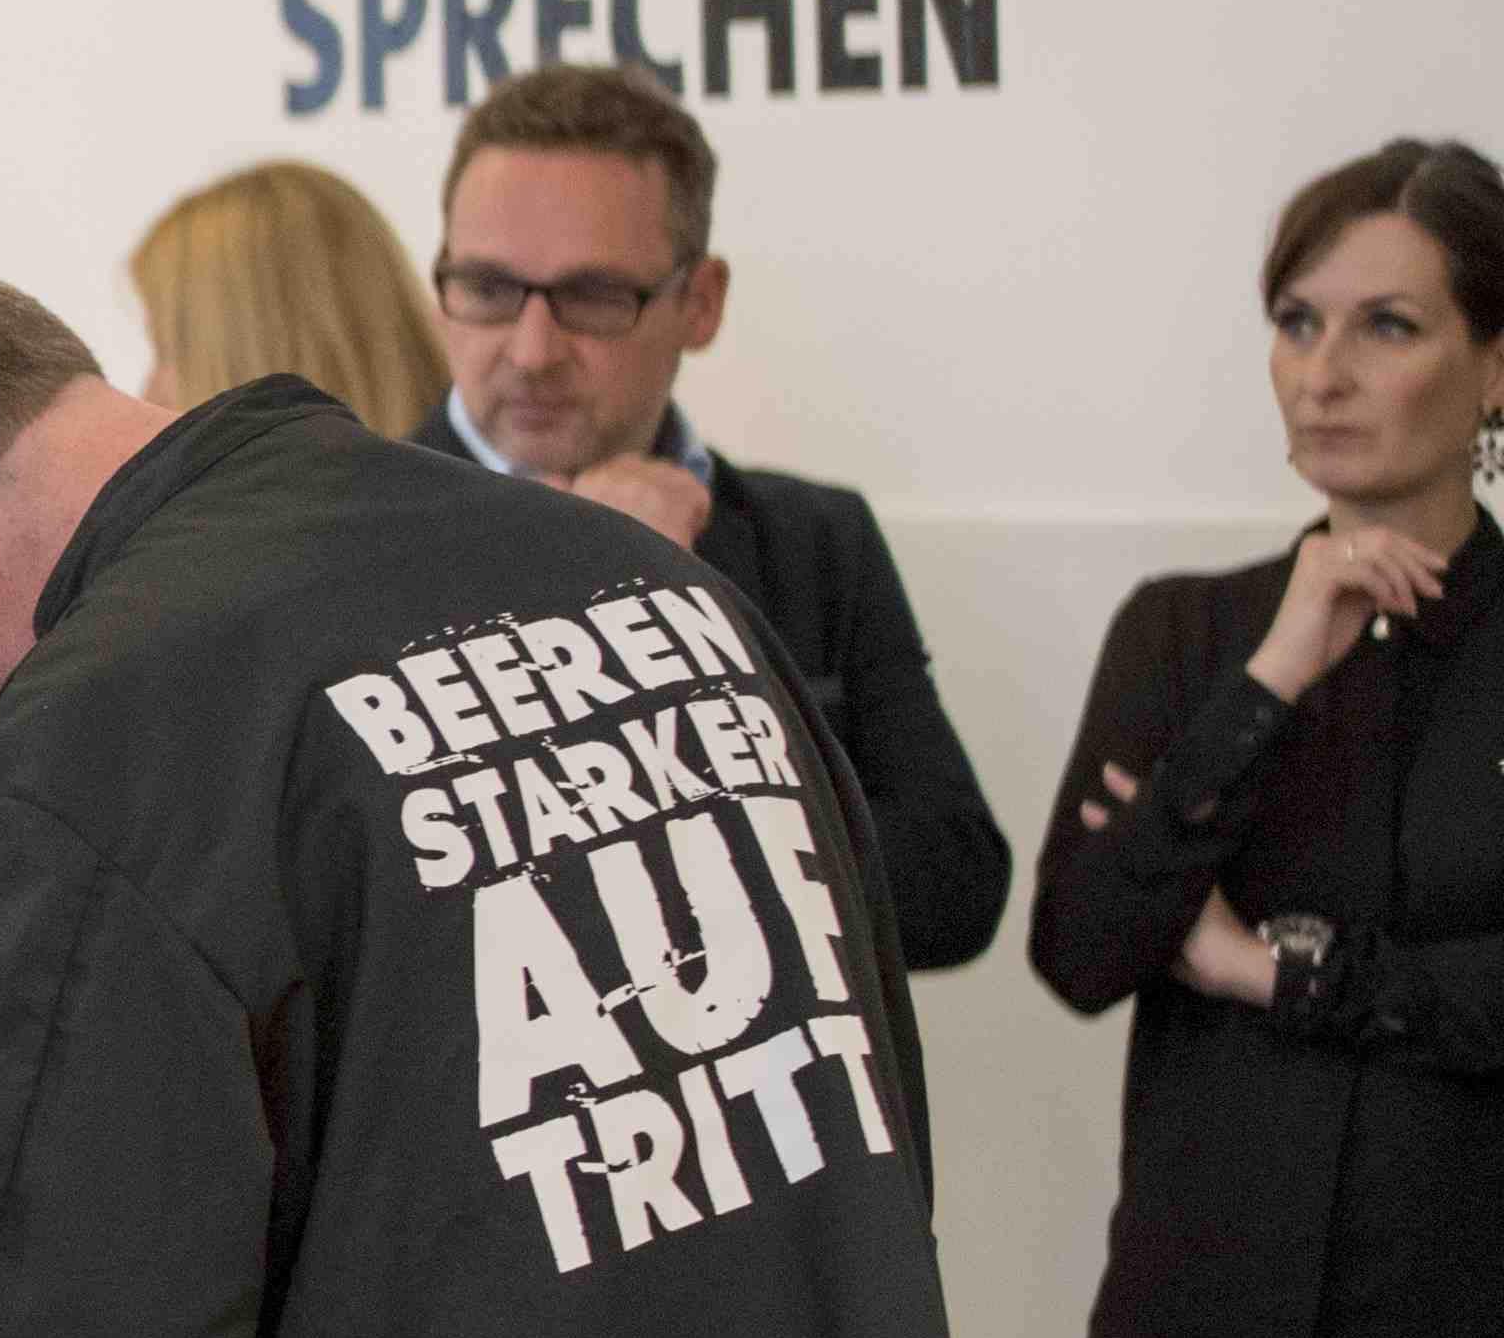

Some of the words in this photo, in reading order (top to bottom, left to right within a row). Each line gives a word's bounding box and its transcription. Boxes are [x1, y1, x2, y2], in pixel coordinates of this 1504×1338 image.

[326, 585, 756, 776] BEEREN
[400, 693, 802, 890] STARKER
[472, 795, 850, 1129] AUF
[492, 1014, 895, 1274] TRITT
